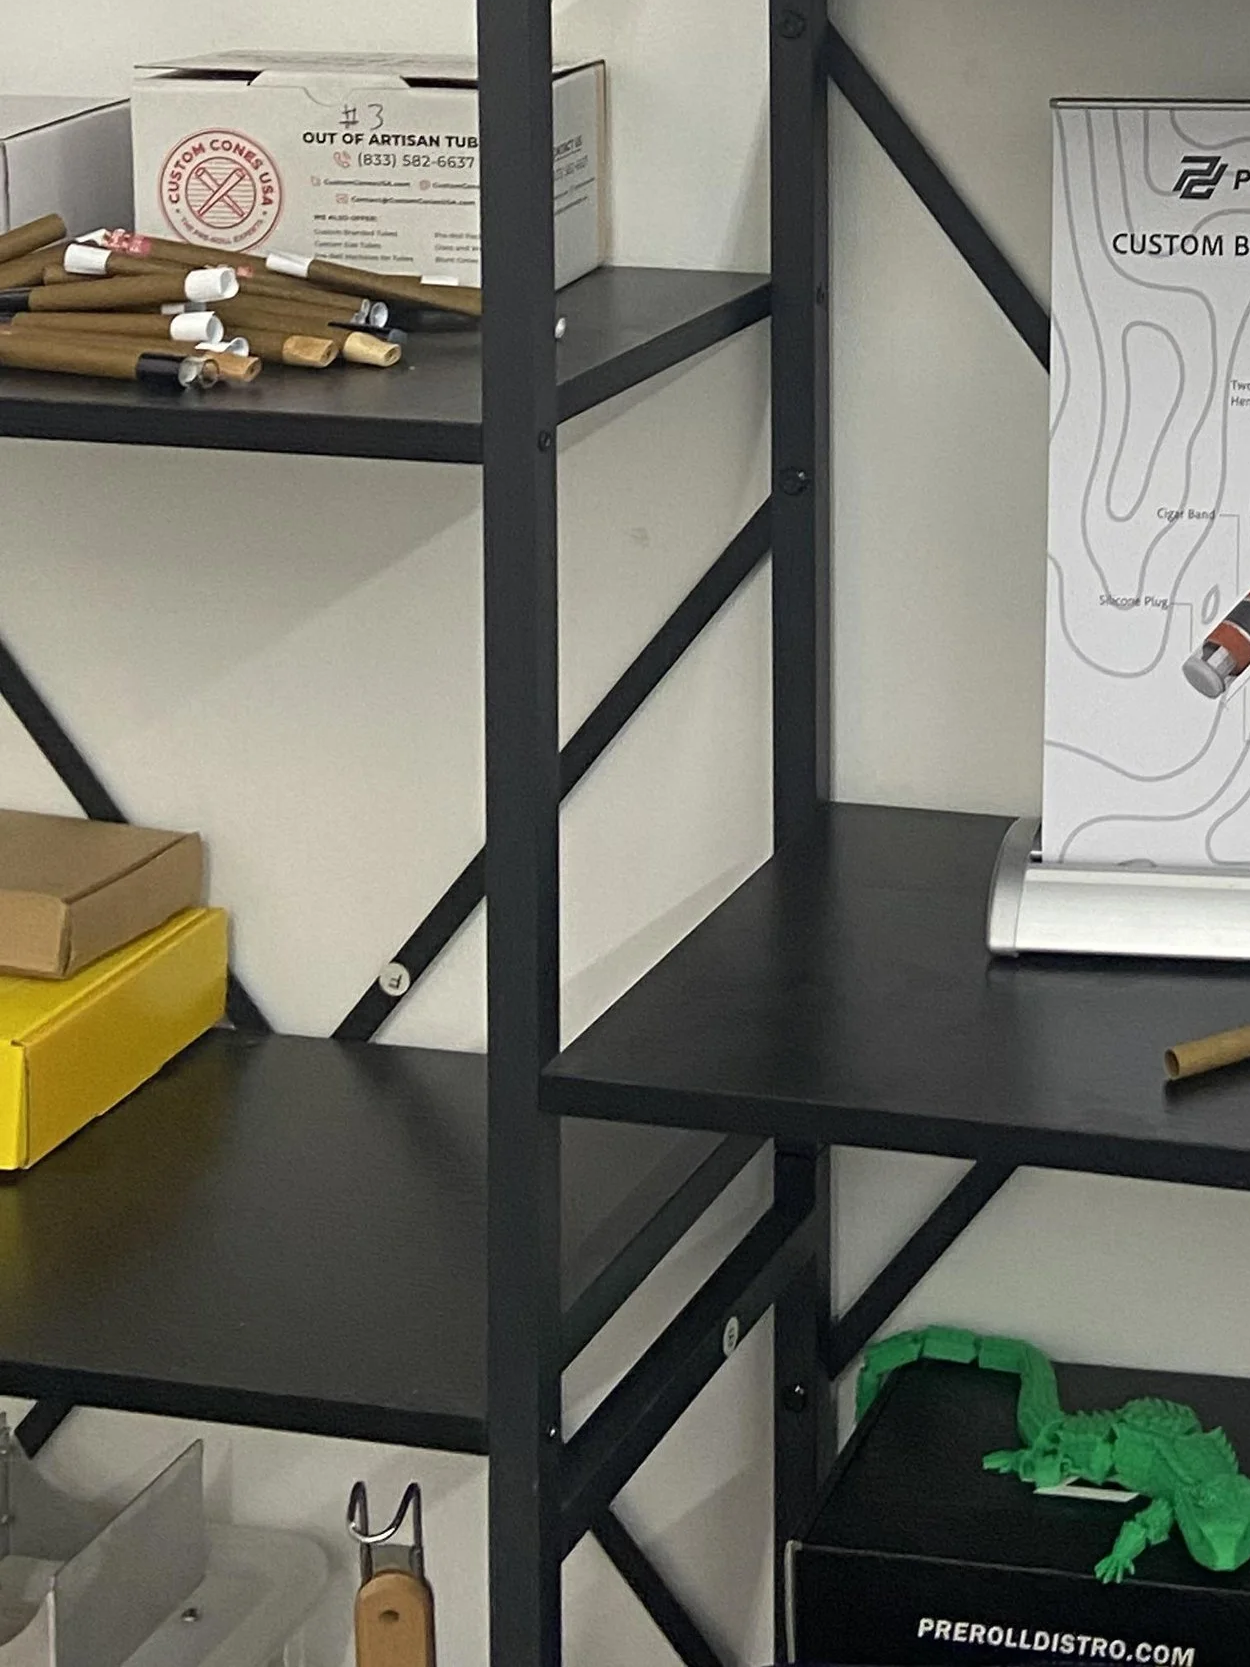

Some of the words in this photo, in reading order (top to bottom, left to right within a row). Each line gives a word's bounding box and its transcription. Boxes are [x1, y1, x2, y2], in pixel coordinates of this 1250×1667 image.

[303, 132, 338, 145] OUT
[342, 133, 364, 145] OF
[369, 134, 440, 147] ARTISAN
[445, 135, 479, 148] TUB
[358, 152, 397, 168] (833)
[402, 154, 476, 169] 582-6637
[168, 142, 206, 204] CUSTOM
[209, 139, 264, 170] CONES
[259, 172, 274, 206] USA
[1112, 233, 1224, 257] CUSTOM
[1156, 507, 1185, 521] Cigar
[1188, 509, 1216, 520] Band
[1099, 594, 1141, 607] Silicone
[1143, 594, 1169, 611] Plug
[917, 1617, 1197, 1667] PREROLLDISTRO.COM
